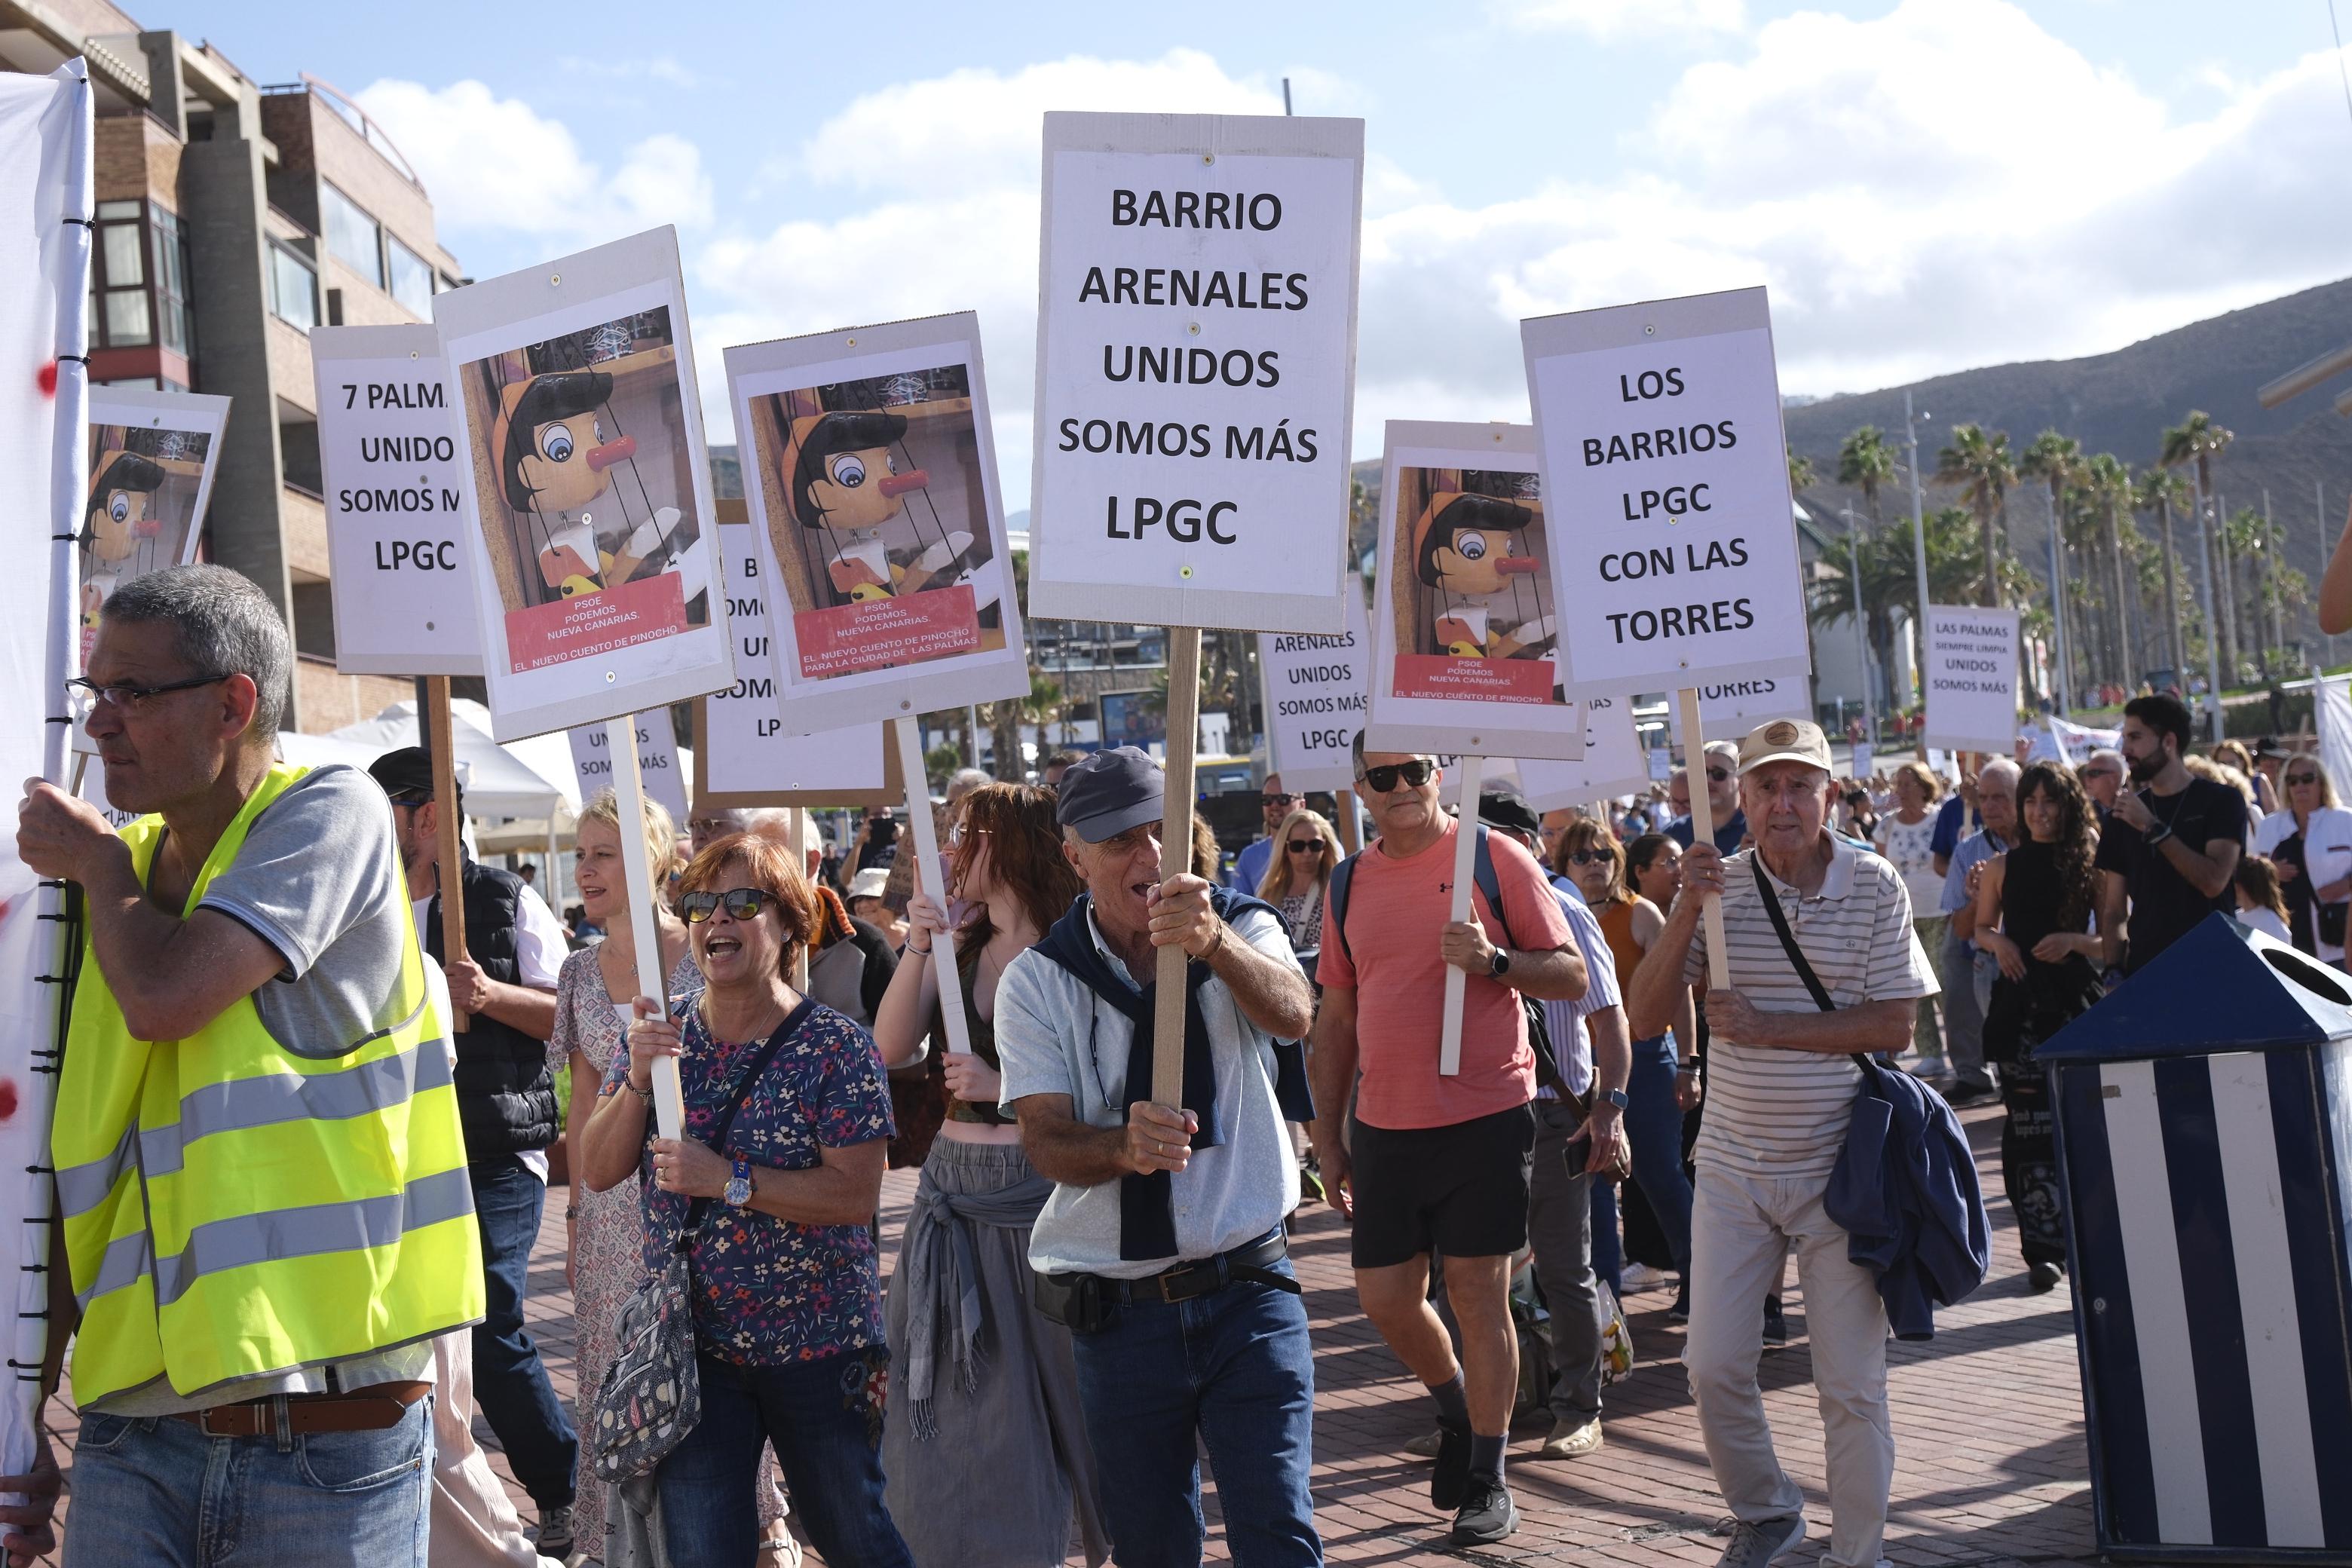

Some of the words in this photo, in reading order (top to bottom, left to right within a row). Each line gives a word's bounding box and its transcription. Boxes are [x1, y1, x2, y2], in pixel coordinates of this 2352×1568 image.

[1113, 190, 1282, 231] BARRIO
[1079, 267, 1308, 311] ARENALES
[1104, 345, 1279, 387] UNIDOS
[342, 385, 357, 409] 7
[368, 383, 448, 409] PALM
[1621, 368, 1684, 402] LOS
[362, 436, 454, 462] UNIDO
[1059, 418, 1210, 458] SOMOS
[1226, 419, 1317, 462] MÁS
[1583, 421, 1736, 466] BARRIOS
[340, 489, 433, 512] SOMOS
[1623, 483, 1710, 522] LPGC
[1107, 496, 1237, 544] LPGC
[375, 541, 455, 570] LPGC
[1600, 547, 1674, 581] CON
[1687, 538, 1747, 571] LAS
[565, 605, 616, 624] PODEMOS
[574, 596, 602, 610] PSOE
[865, 602, 893, 613] PSOE
[547, 626, 583, 640] NUEVA
[584, 611, 640, 632] CANARIAS.
[837, 624, 872, 637] NUEVA
[874, 615, 932, 631] CANARIAS.
[855, 609, 907, 624] PODEMOS
[1606, 599, 1753, 643] TORRES
[1275, 631, 1355, 653] ARENALES
[1935, 623, 1957, 635] LAS
[1960, 625, 2009, 639] PALMAS
[514, 662, 527, 672] EL
[531, 651, 568, 668] NUEVO
[570, 641, 612, 659] CUENTO
[614, 637, 628, 648] DE
[629, 624, 678, 645] PINOCHO
[803, 654, 815, 663] EL
[821, 648, 858, 660] NUEVO
[860, 639, 902, 654] CUENTO
[905, 636, 919, 645] DE
[921, 628, 969, 642] PINOCHO
[804, 662, 833, 672] PARA
[835, 659, 849, 667] LA
[851, 651, 890, 664] CIUDAD
[893, 648, 906, 657] DE
[912, 645, 933, 654] LAS
[934, 636, 978, 651] PALMAS
[1288, 665, 1351, 684] UNIDOS
[1447, 667, 1493, 675] PODEMOS
[1946, 659, 1998, 673] UNIDOS
[1462, 677, 1513, 686] CANARIAS.
[1933, 679, 1978, 692] SOMOS
[1981, 681, 2008, 694] MÁS
[1279, 698, 1334, 715] SOMOS
[1338, 692, 1367, 711] MÁS
[1302, 729, 1349, 749] LPGC
[581, 760, 613, 775] SOM
